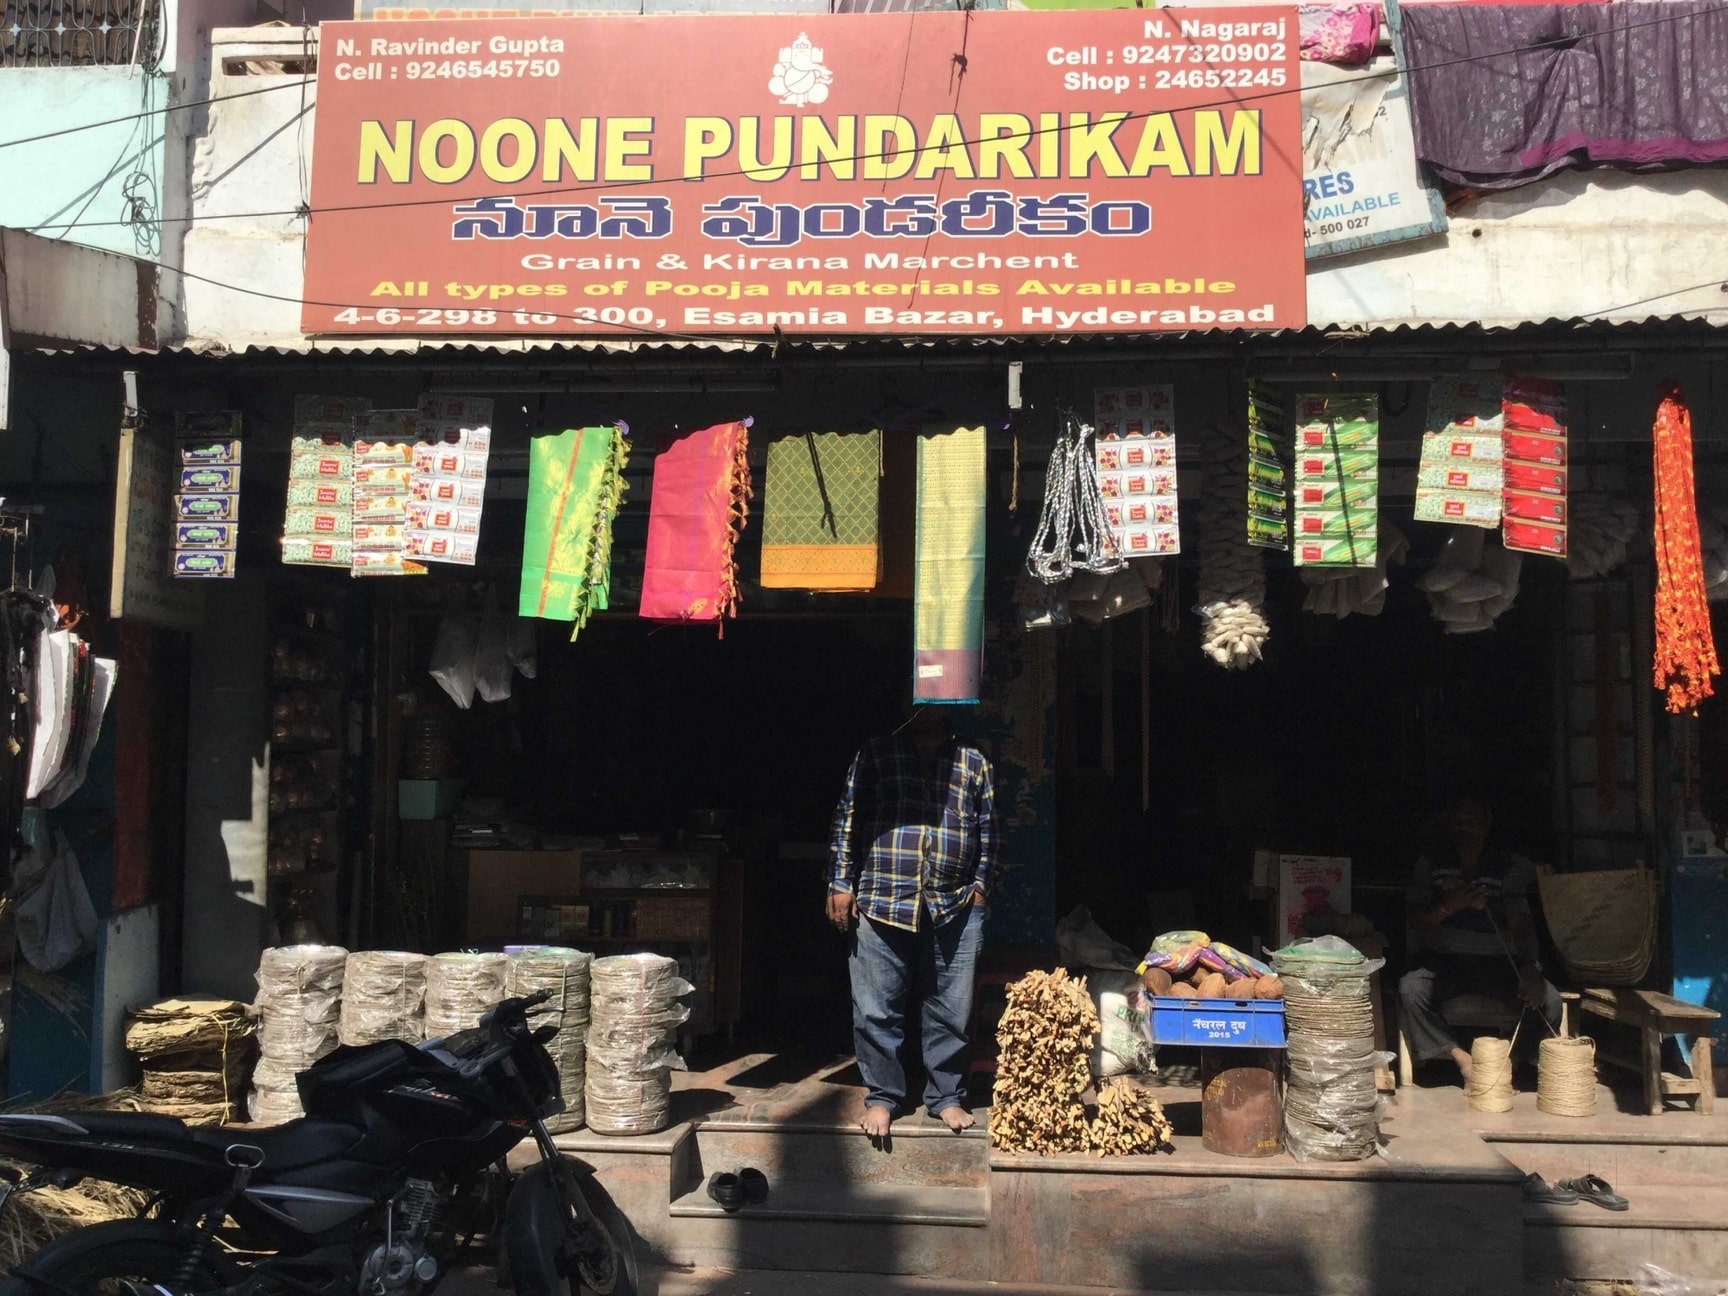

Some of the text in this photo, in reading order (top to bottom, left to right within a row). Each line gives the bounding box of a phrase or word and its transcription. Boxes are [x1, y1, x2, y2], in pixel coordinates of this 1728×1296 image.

[1144, 18, 1286, 41] N. Nagaraj
[337, 35, 565, 57] N. Ravinder Gupta
[1047, 47, 1098, 66] Cell
[1122, 43, 1287, 64] 9247320902
[335, 62, 382, 80] Cell
[406, 59, 561, 80] 9246545750
[1064, 71, 1131, 93] Shop
[1155, 68, 1287, 88] 24652245
[357, 117, 653, 184] NOONE
[683, 109, 1263, 182] PUNDARIKAM
[1320, 221, 1343, 235] 500
[1347, 216, 1370, 230] 027
[521, 252, 1080, 271] Grain & Kirana Marchent
[371, 278, 1236, 300] All types of Pooja Materials Available
[334, 304, 1275, 329] 4-6-298 to 300, Esamia Bazar, Hyderabad
